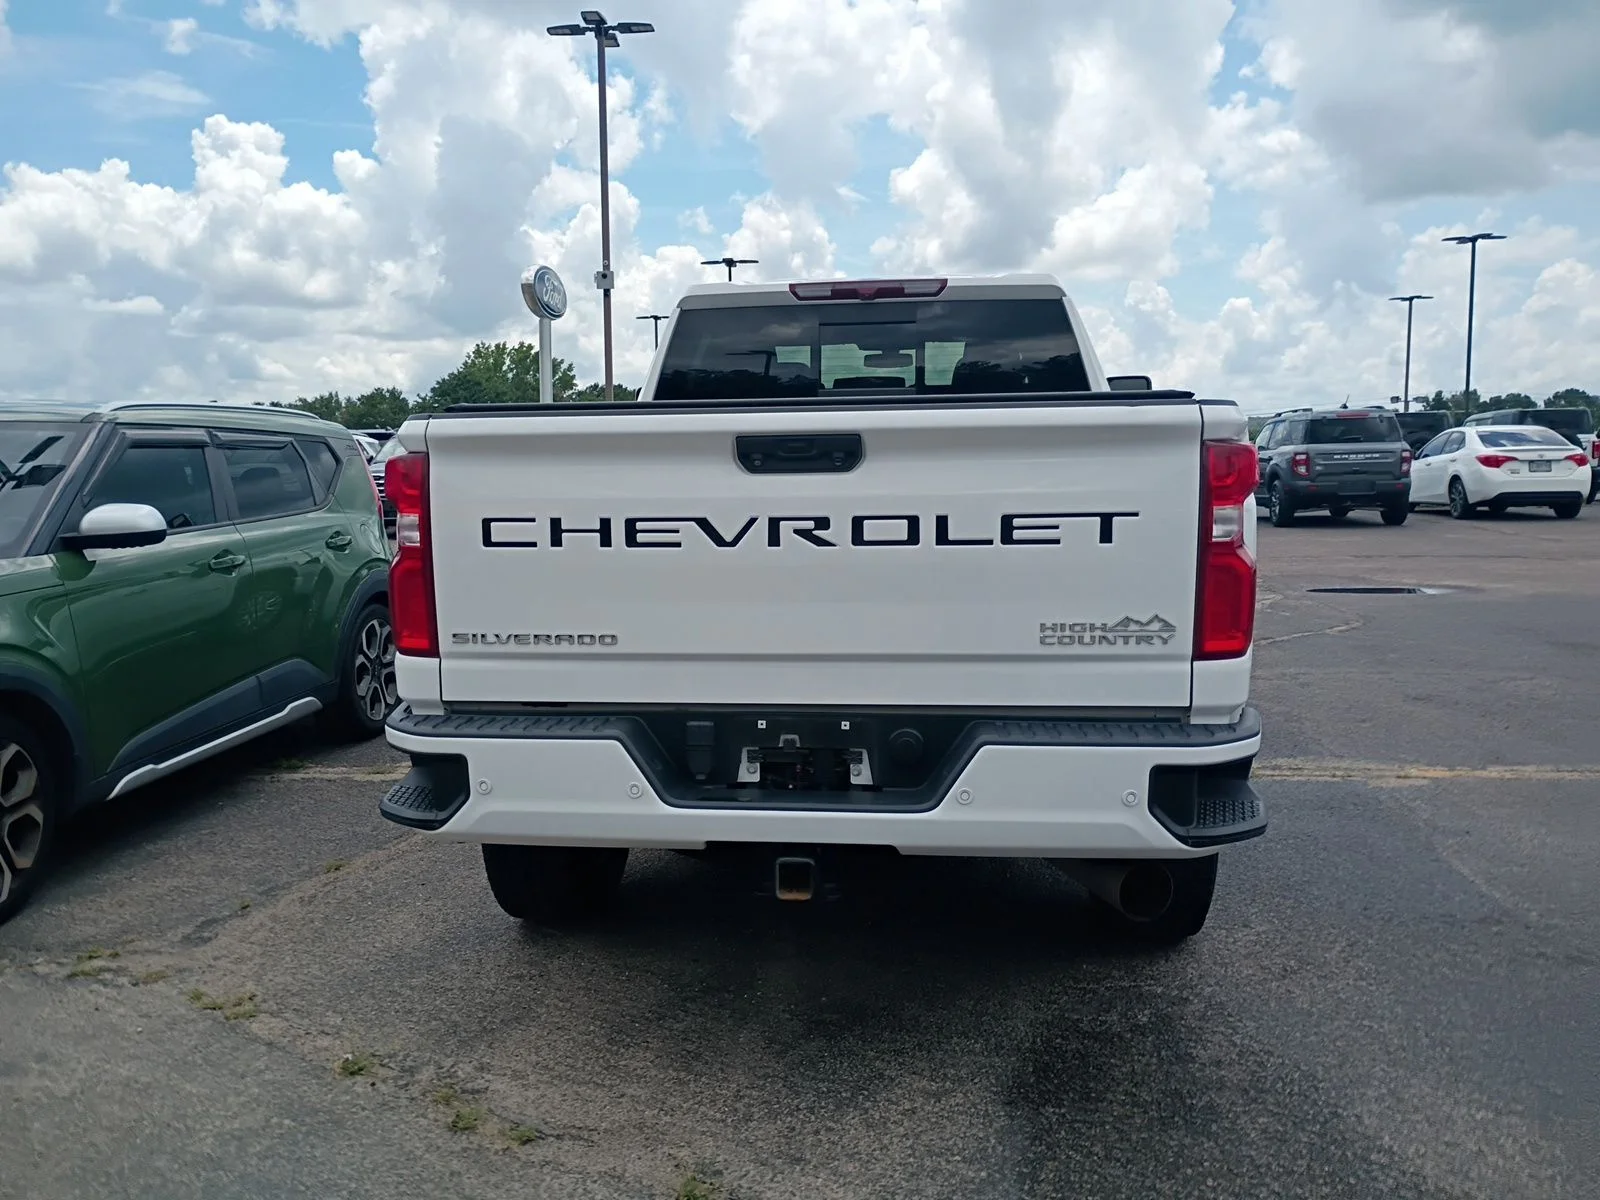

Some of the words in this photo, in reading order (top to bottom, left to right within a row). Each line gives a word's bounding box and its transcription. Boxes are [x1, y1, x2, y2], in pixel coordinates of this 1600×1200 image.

[542, 274, 563, 309] Ford
[481, 511, 1140, 549] CHEVROLET
[1039, 622, 1109, 634] HIGH
[451, 633, 619, 647] SILVERADO
[1039, 633, 1176, 646] COUNTRY
